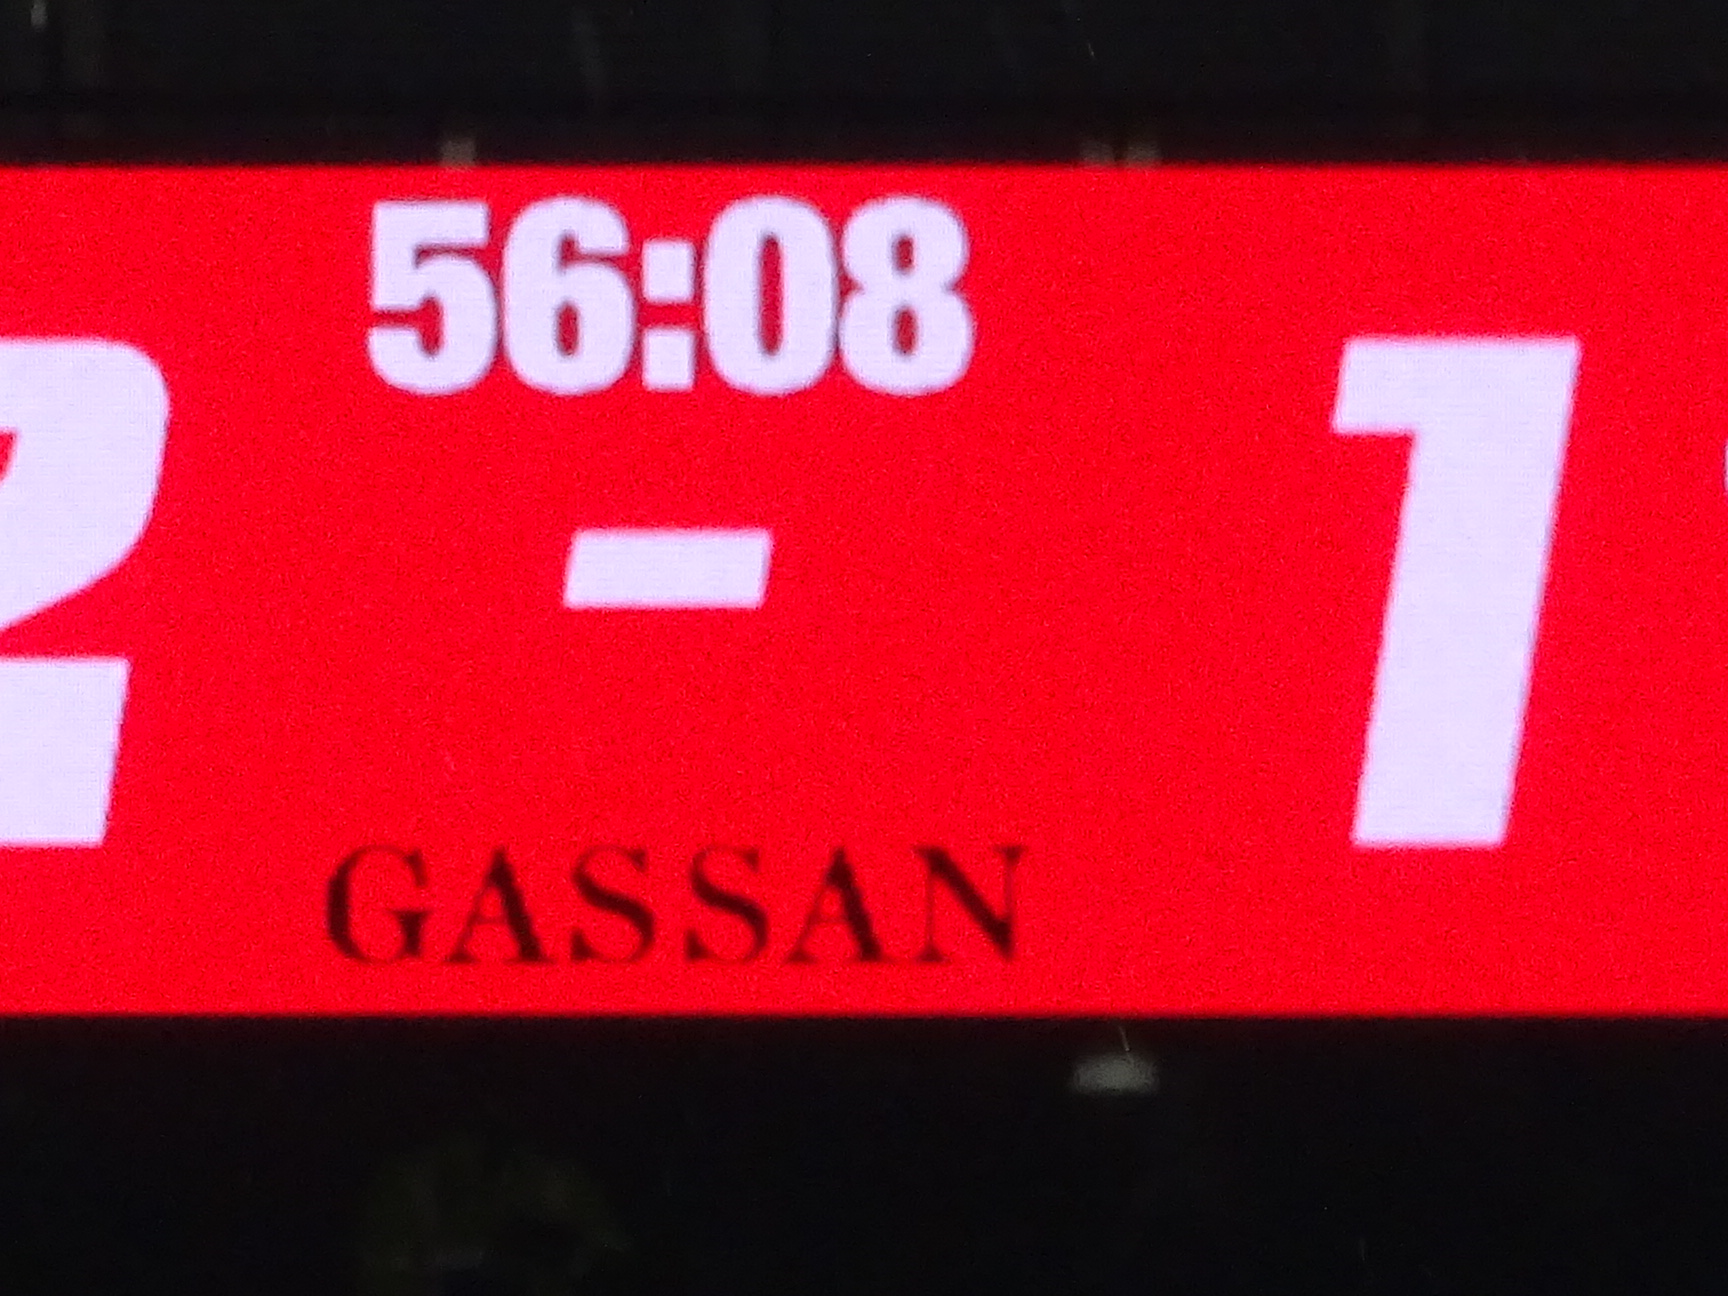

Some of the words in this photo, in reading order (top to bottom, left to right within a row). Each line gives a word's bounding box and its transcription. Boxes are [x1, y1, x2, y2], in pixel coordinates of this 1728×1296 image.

[366, 194, 975, 397] 56:08
[1331, 335, 1582, 847] 1
[324, 844, 1030, 967] GASSAN
